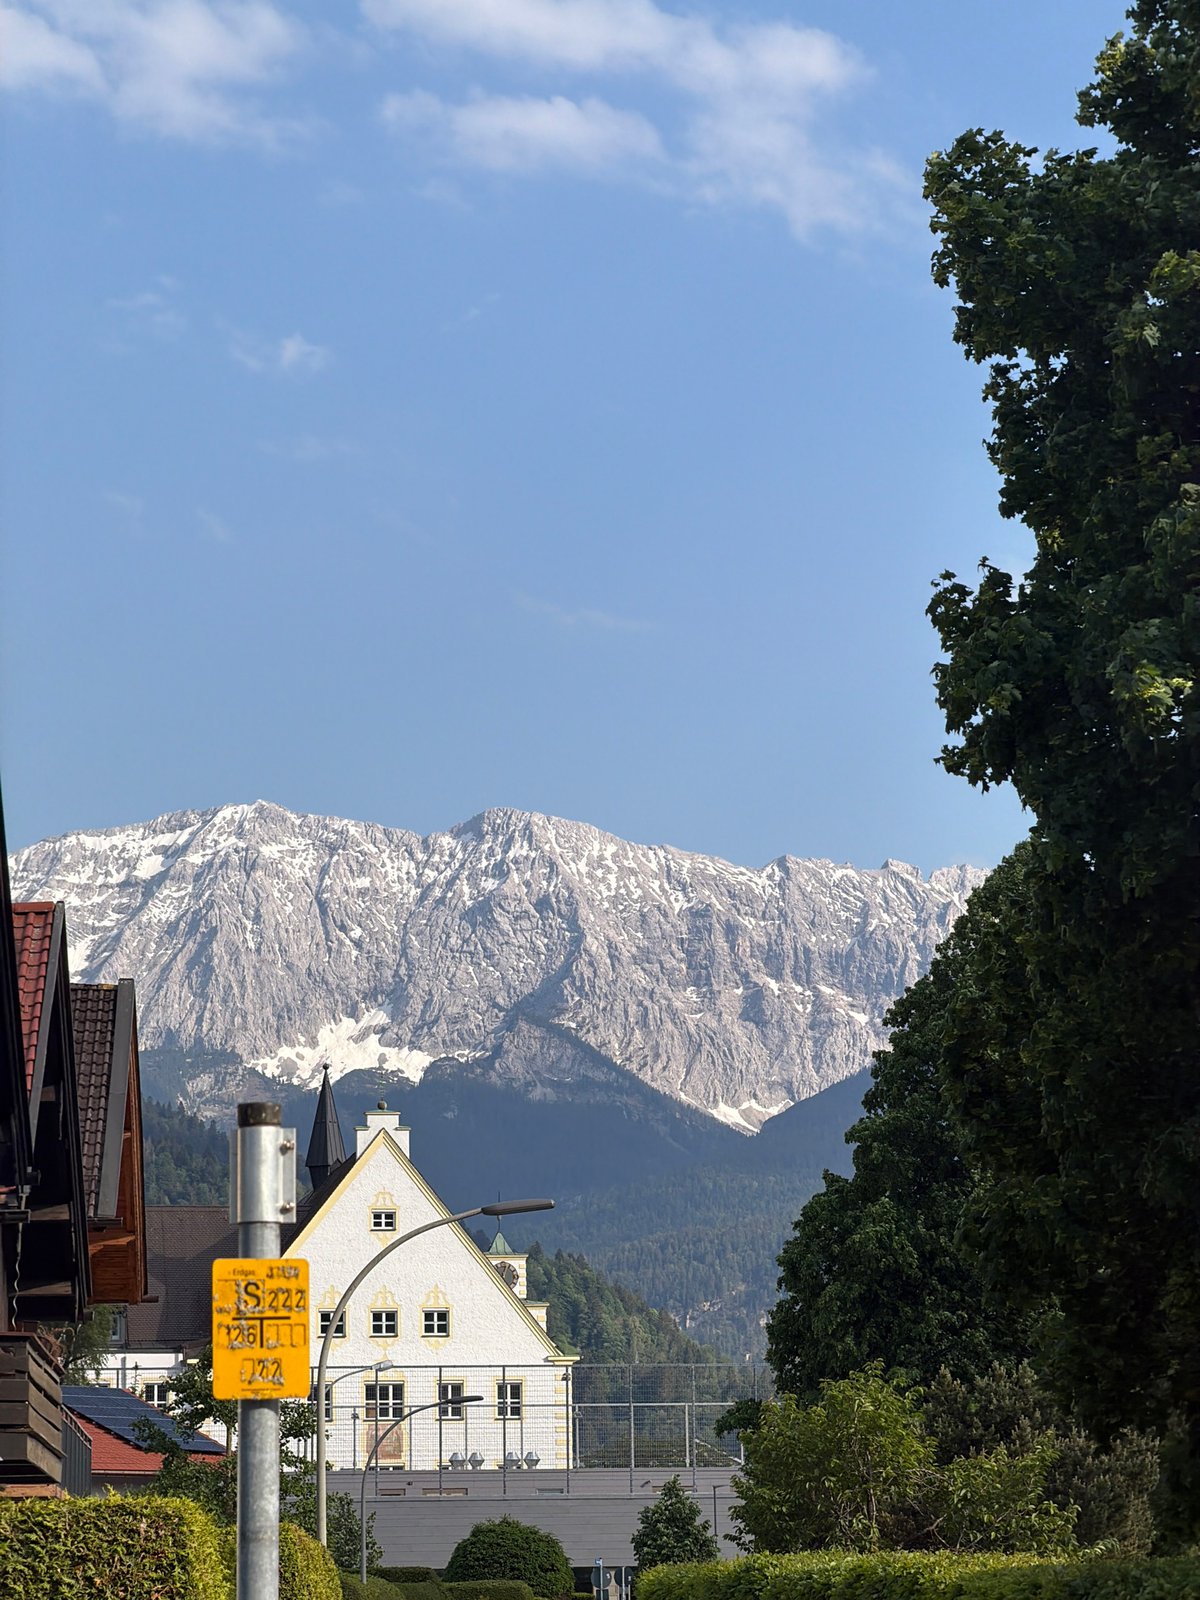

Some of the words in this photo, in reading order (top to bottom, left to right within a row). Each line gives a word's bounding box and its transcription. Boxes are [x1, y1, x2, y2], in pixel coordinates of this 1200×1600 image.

[232, 1268, 256, 1277] Erdgas
[243, 1281, 261, 1309] S
[268, 1289, 306, 1309] 222
